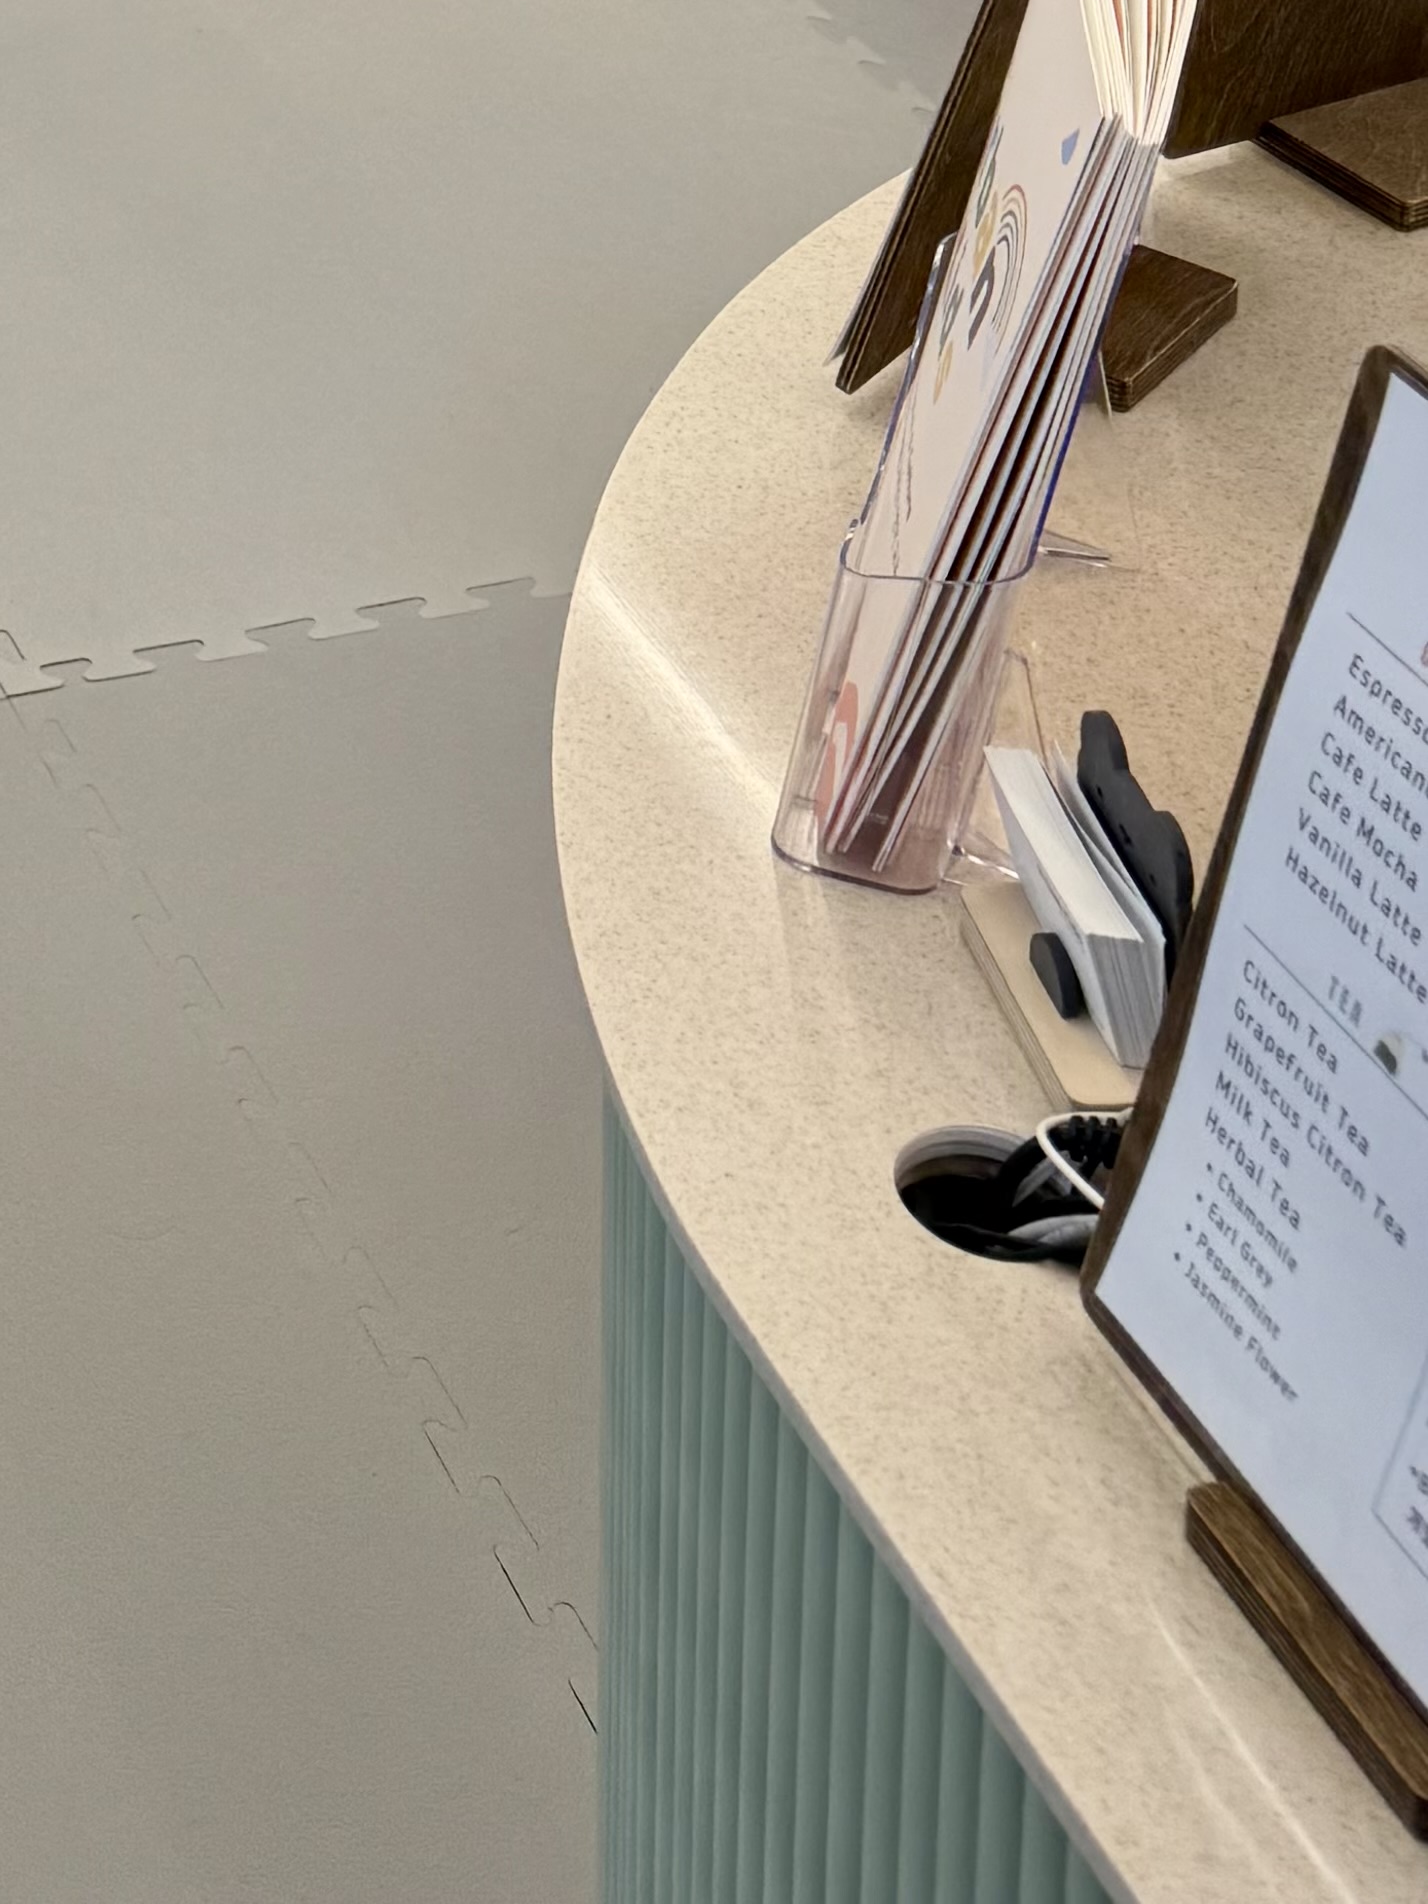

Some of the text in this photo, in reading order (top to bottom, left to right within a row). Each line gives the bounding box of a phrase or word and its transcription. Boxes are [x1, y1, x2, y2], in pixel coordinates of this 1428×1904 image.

[1320, 732, 1422, 842] Cafe Latte
[1333, 694, 1428, 800] American
[1298, 807, 1422, 947] Vanilla Latte
[1308, 771, 1418, 893] Cafe Mocha
[1285, 845, 1428, 1004] Hazelnut Latte
[1243, 959, 1339, 1075] Citron Tea
[1215, 1071, 1291, 1169] Milk Tea
[1234, 997, 1370, 1158] Grapefruit Tea
[1205, 1107, 1301, 1232] Herbal Tea
[1224, 1032, 1407, 1248] Hibiscus Citron Tea
[1207, 1201, 1238, 1247] Earl
[1217, 1171, 1299, 1274] Chamomile
[1185, 1262, 1299, 1402] Jasmine Flower
[1195, 1231, 1282, 1341] Peppermint
